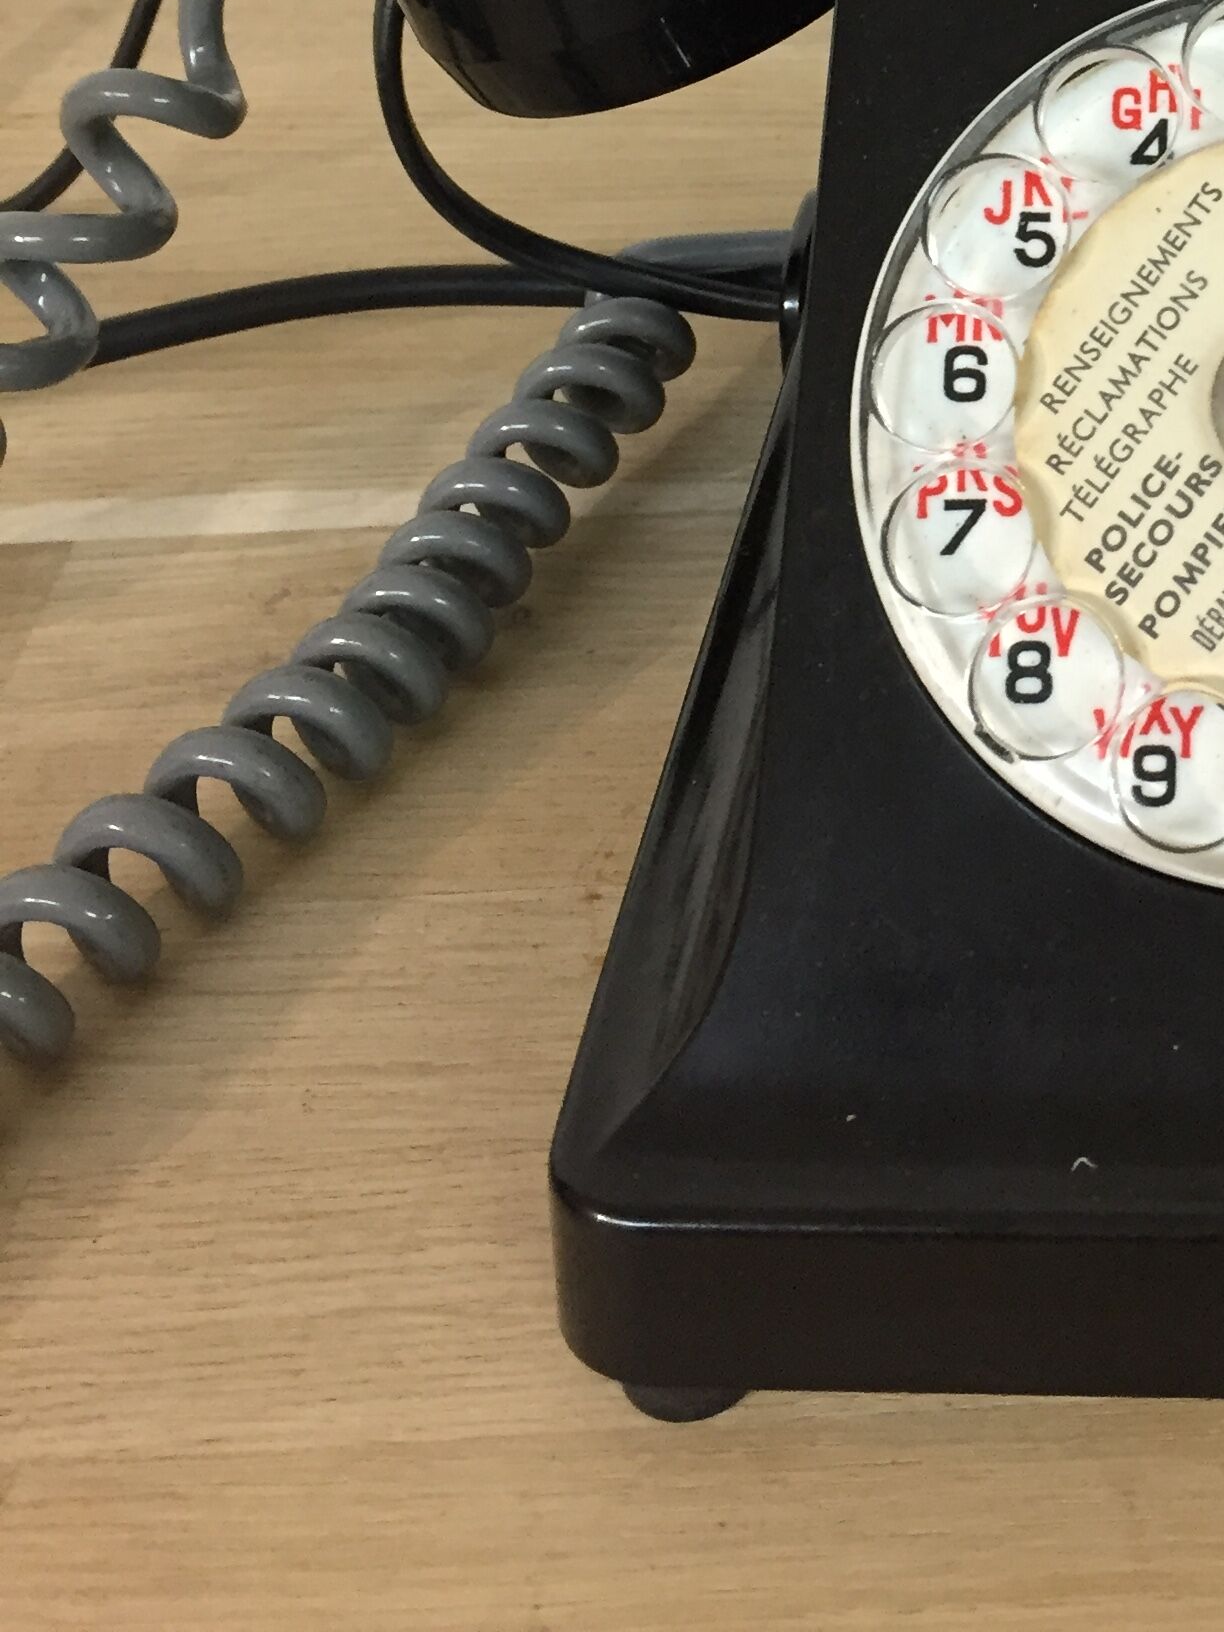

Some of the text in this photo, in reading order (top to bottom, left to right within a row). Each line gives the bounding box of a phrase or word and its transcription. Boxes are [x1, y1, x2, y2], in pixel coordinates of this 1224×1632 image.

[1130, 119, 1173, 166] 4
[1014, 211, 1056, 268] 5
[1040, 181, 1223, 415] RENSEIGNEMENTS
[943, 344, 989, 403] 6
[1045, 270, 1209, 475] RÉCLAMATIONS
[1060, 353, 1199, 523] TÉLÉGRAPHE
[939, 498, 988, 556] 7
[1084, 451, 1184, 574] POLICE-
[1105, 454, 1223, 606] SECOURS
[980, 582, 1080, 657] UV
[1005, 640, 1054, 704] 8
[1132, 744, 1178, 808] 9
